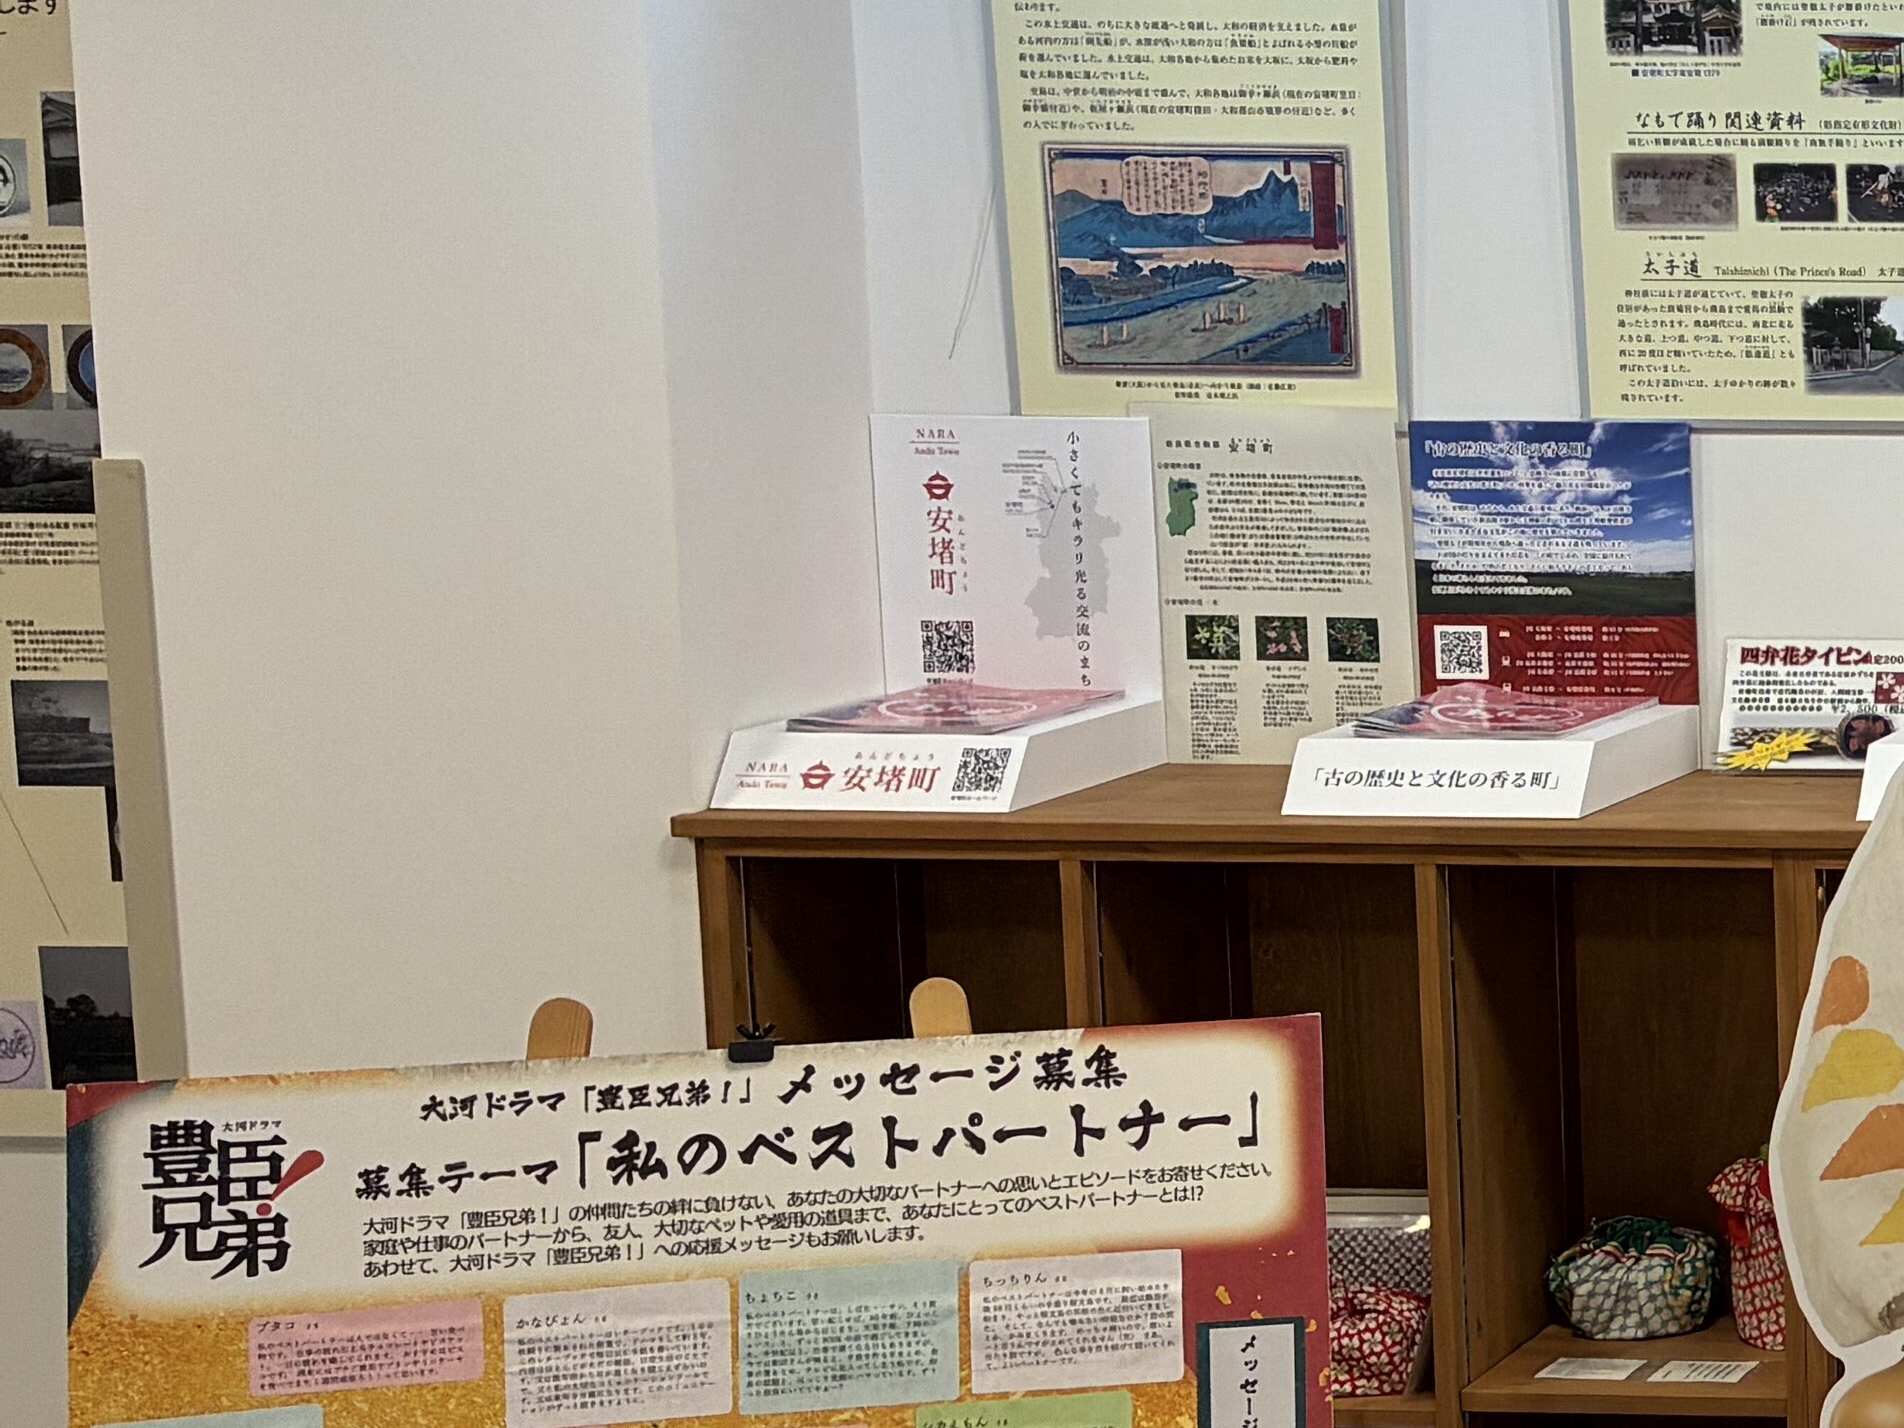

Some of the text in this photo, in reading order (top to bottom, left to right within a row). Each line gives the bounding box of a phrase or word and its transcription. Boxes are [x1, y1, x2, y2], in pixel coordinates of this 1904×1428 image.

[1643, 258, 1701, 277] 太子道
[1714, 267, 1769, 276] Taishimichi
[917, 429, 955, 439] NARA
[914, 447, 936, 455] Ando
[927, 506, 957, 595] 安堵町
[1068, 431, 1091, 686] 小さくてもキラリ光る交流のまち
[1741, 645, 1872, 666] 四弁花タイピン
[748, 762, 940, 793] NARA 安堵町
[1314, 765, 1559, 793] 「古の歴史と文化の香る町」
[420, 1044, 1129, 1122] 大河ドラマ「豊臣兄弟！」 メッセージ募集
[221, 1120, 282, 1133] 大河ドラマ
[355, 1090, 1260, 1201] 募集テーマ 「私のベストパートナー」
